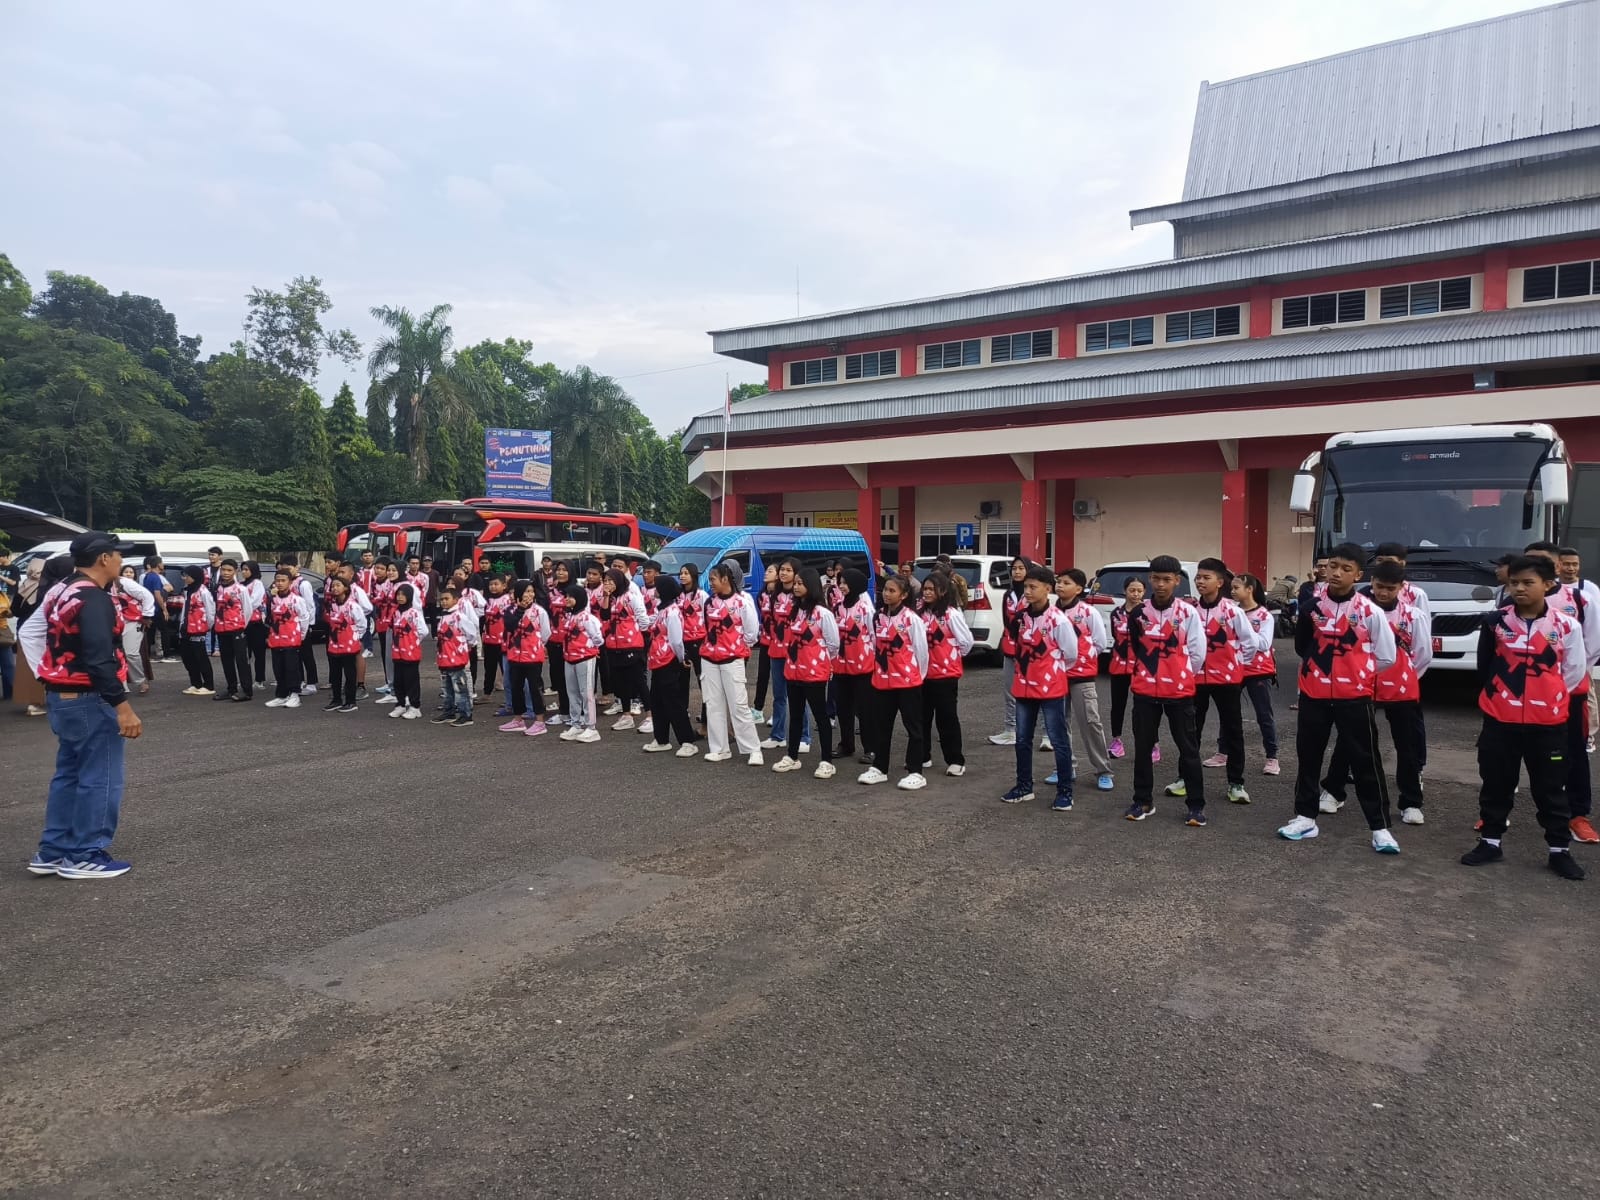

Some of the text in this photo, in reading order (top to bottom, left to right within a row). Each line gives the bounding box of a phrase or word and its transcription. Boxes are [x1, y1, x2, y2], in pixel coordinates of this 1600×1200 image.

[500, 444, 550, 456] PEMUTIHAN
[1429, 450, 1460, 459] armada
[960, 526, 970, 543] P
